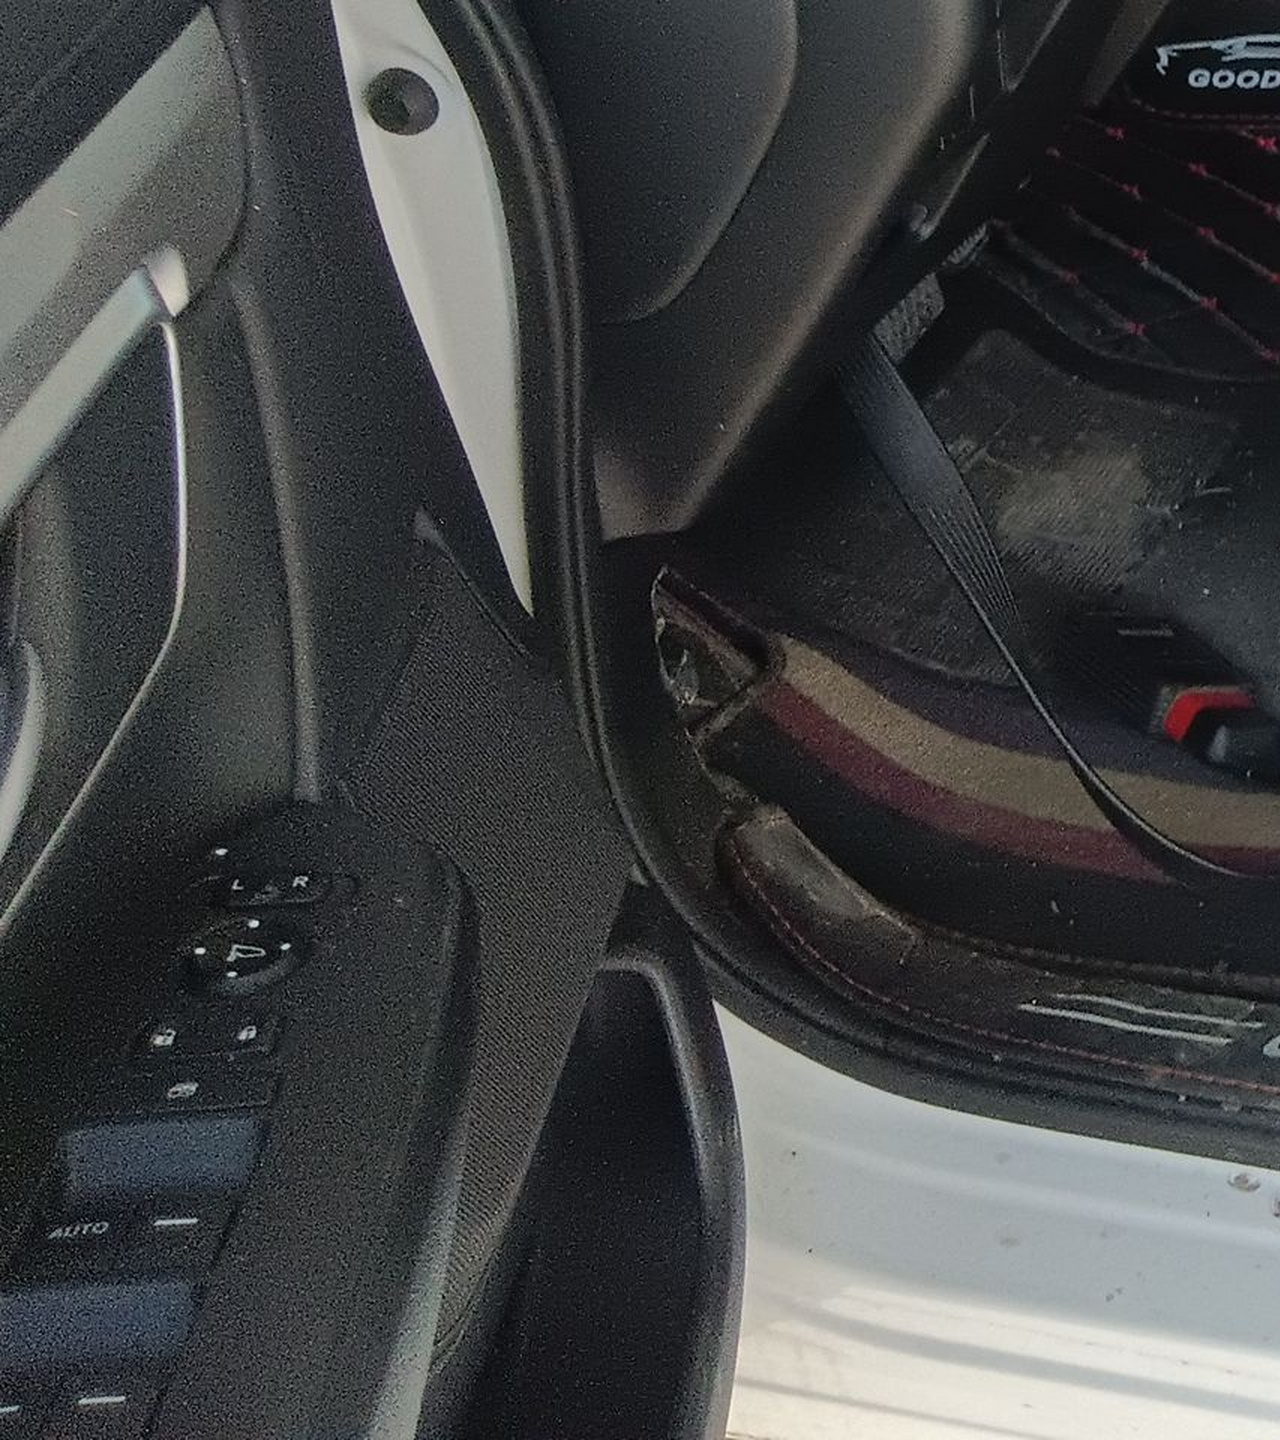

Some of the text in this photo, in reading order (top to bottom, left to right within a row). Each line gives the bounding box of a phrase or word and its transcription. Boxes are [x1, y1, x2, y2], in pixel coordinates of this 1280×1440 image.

[231, 875, 309, 891] L R
[48, 1221, 109, 1239] AUTO
